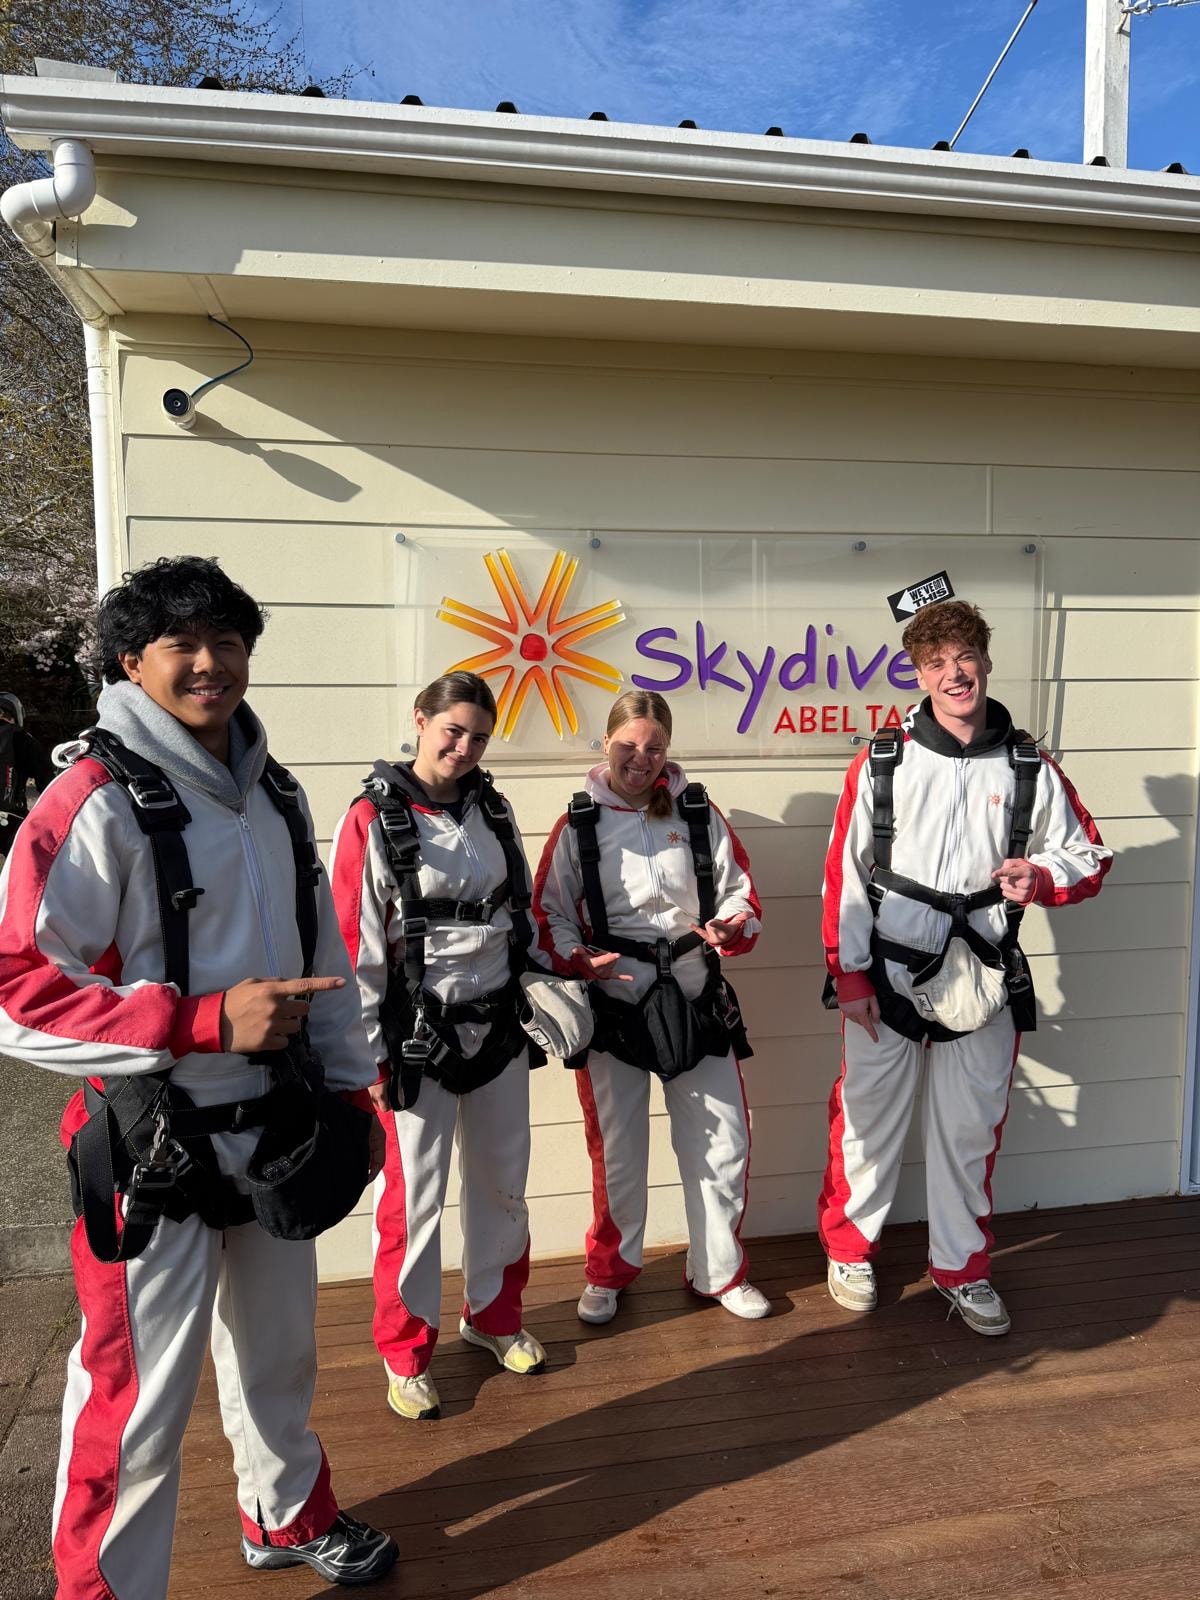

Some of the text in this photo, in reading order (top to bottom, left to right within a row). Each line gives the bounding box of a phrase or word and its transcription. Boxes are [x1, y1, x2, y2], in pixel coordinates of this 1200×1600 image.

[909, 582, 935, 601] WE'VE
[912, 587, 947, 607] THIS
[631, 620, 919, 734] Skydive
[773, 704, 919, 734] ABEL TA
